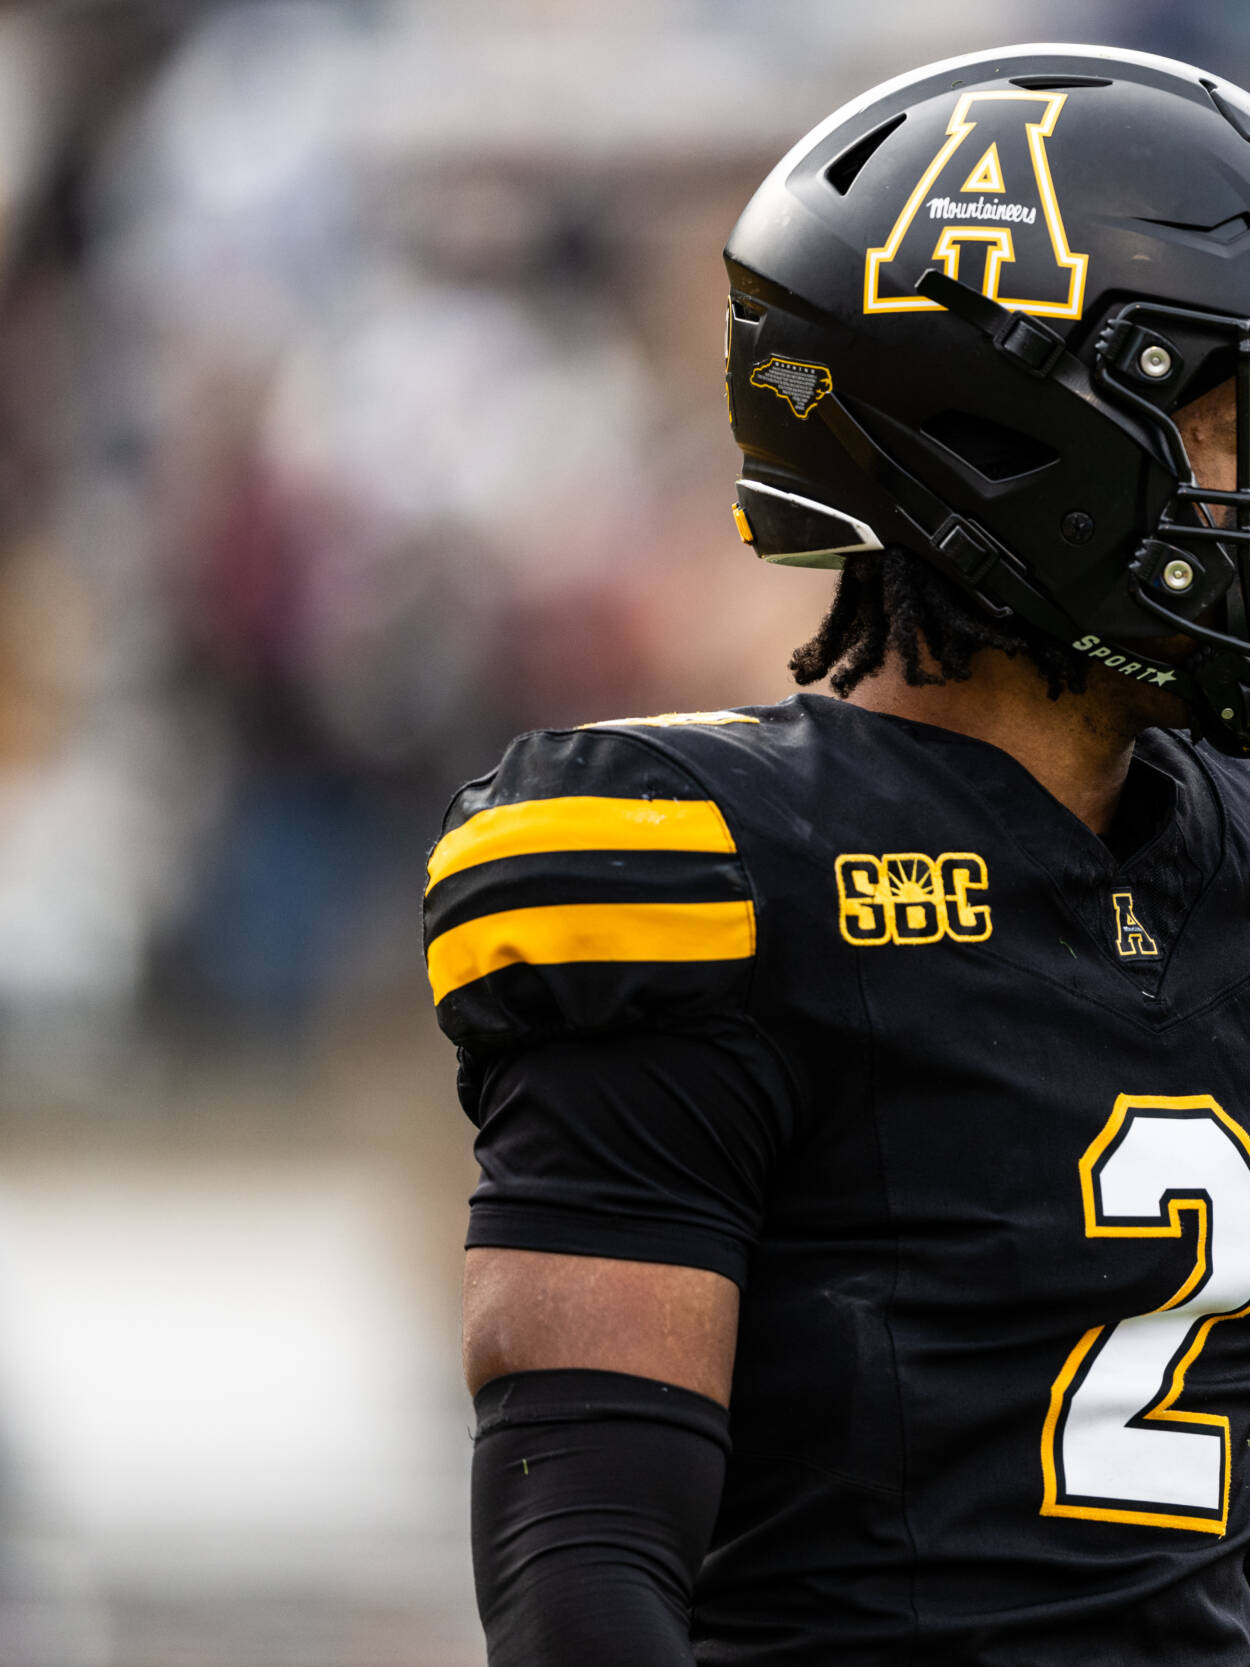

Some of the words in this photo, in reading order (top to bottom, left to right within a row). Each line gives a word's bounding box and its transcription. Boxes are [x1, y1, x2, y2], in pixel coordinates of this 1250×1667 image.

[864, 92, 1089, 320] A
[926, 196, 1037, 224] Mountaineers
[835, 852, 992, 946] SBC
[1112, 892, 1158, 956] A
